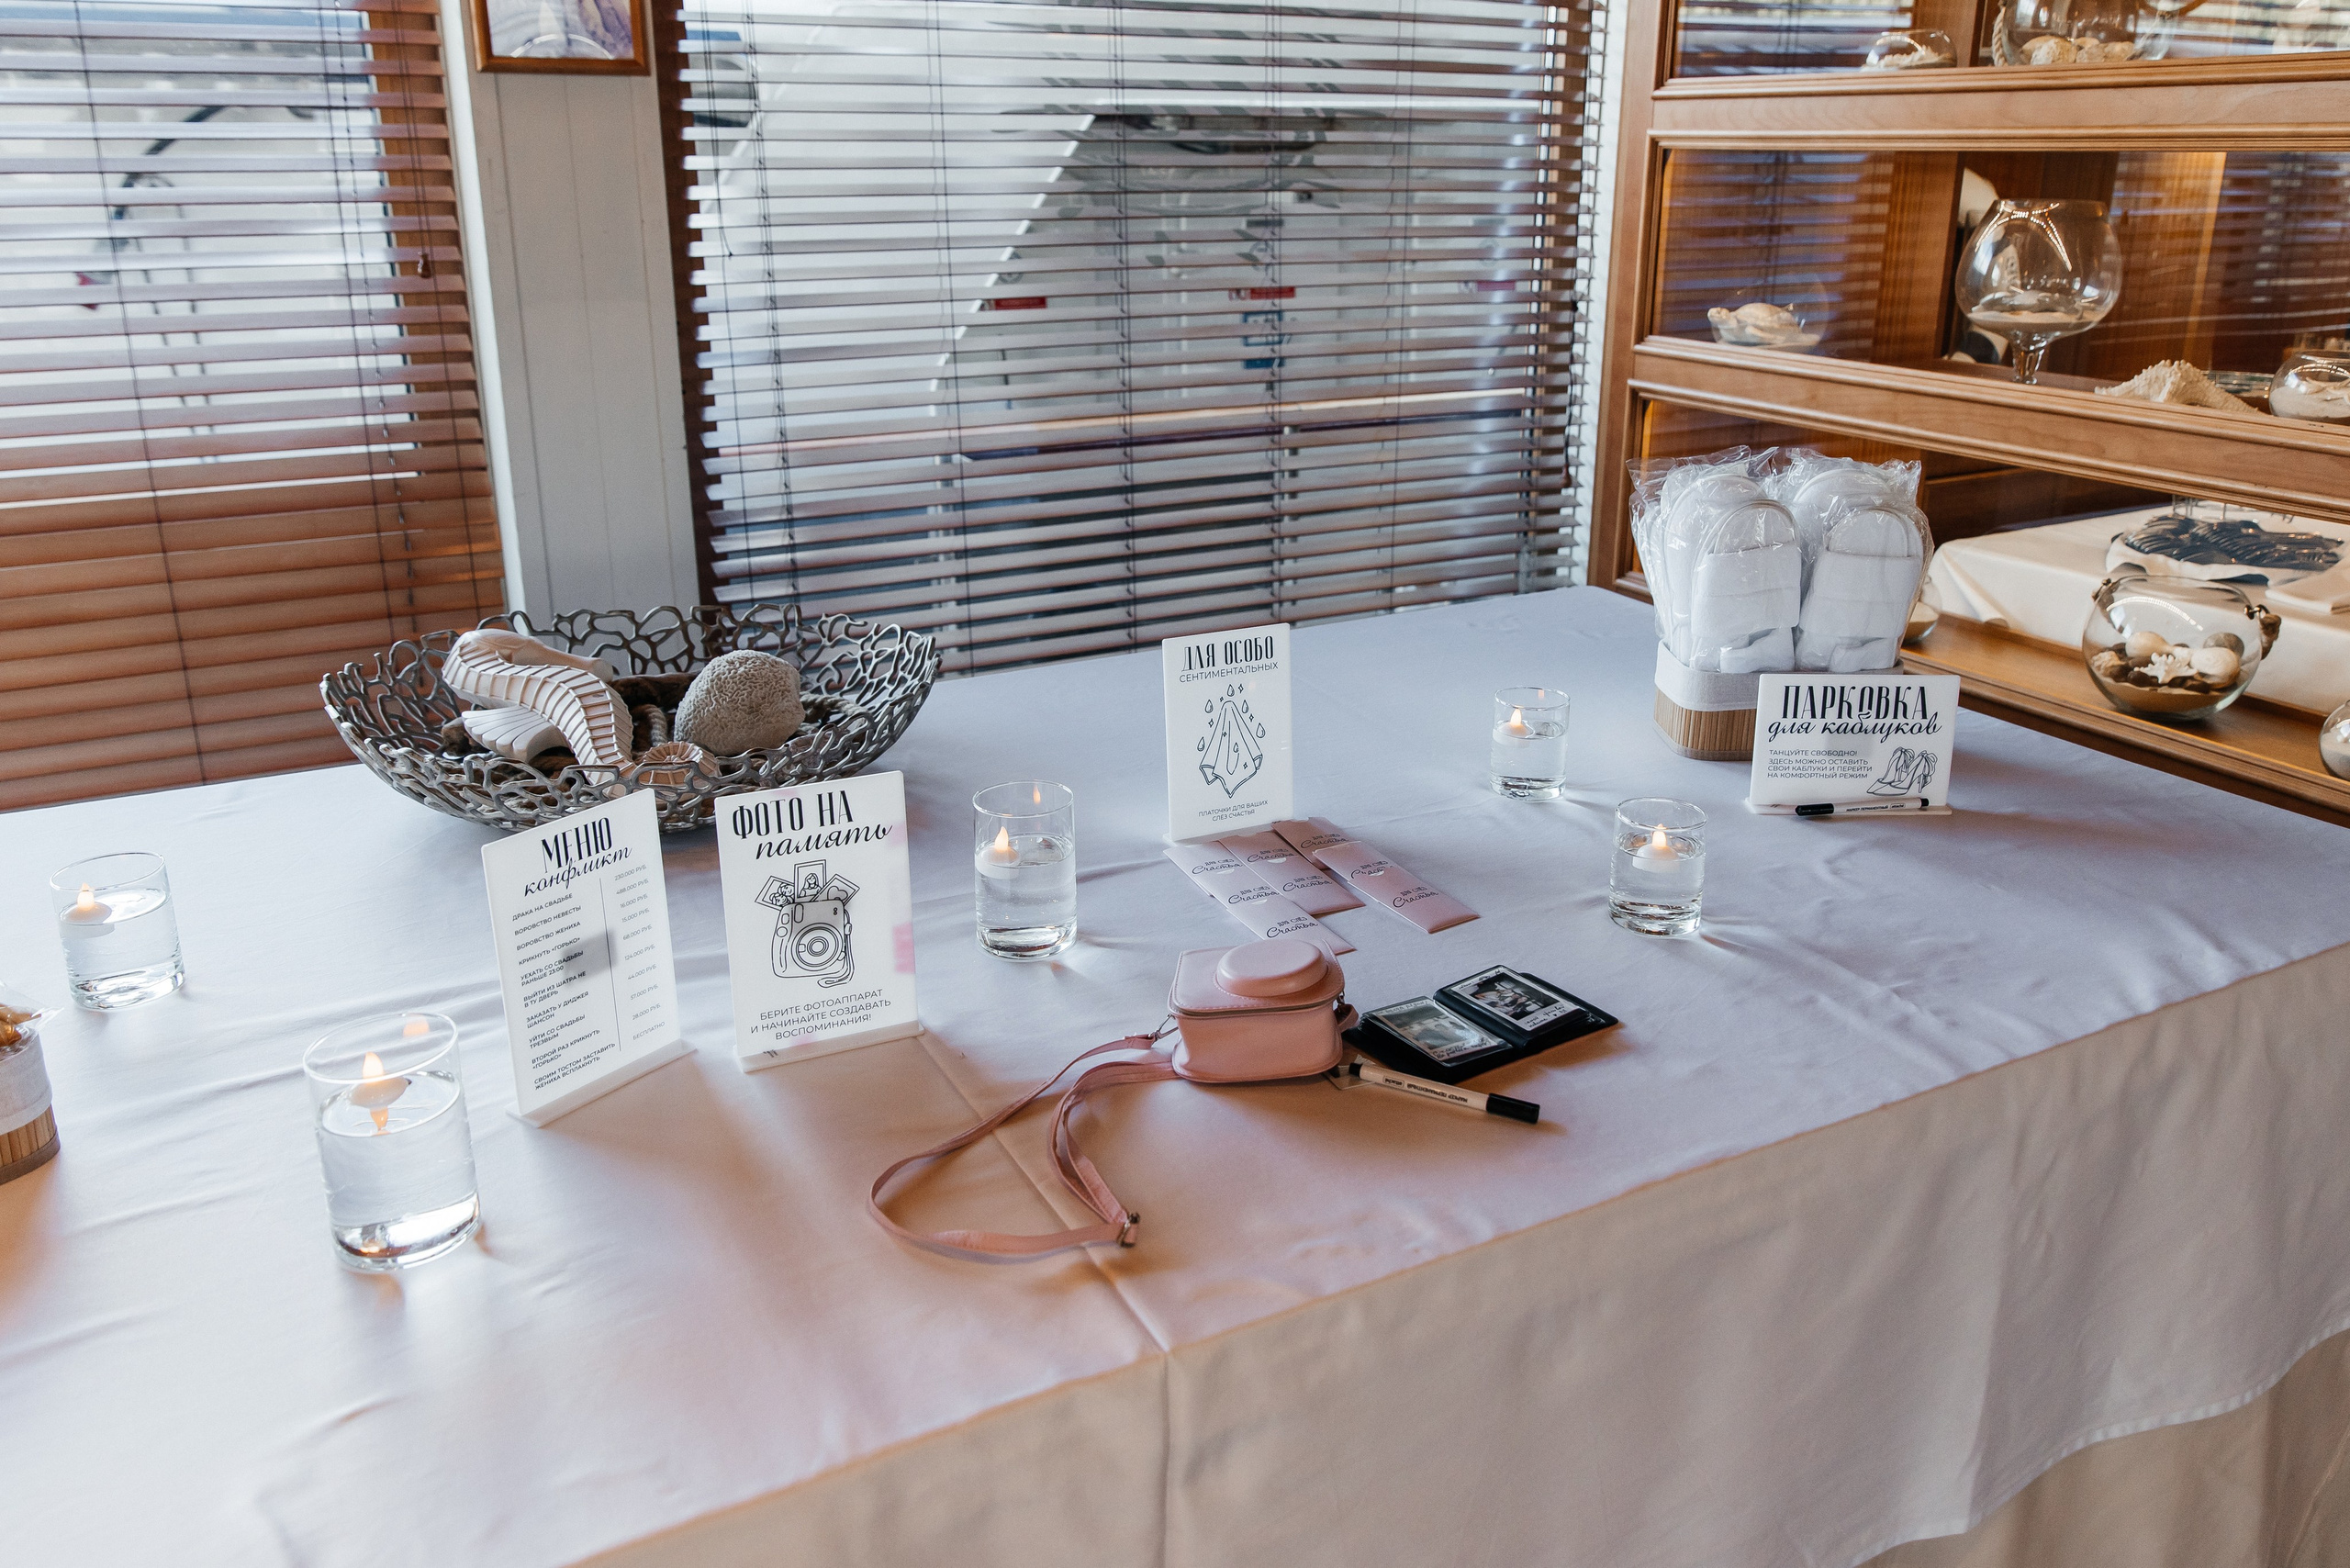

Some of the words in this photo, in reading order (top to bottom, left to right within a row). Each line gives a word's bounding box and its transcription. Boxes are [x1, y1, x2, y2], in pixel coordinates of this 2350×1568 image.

[1181, 643, 1215, 672] ДЛЯ
[1225, 635, 1273, 665] ОСОБО
[1179, 661, 1278, 683] СЕНТИМЕНТАЛЬНЫХ
[1782, 685, 1928, 719] ПАРКОВКА
[1768, 722, 1816, 743] для
[1821, 711, 1942, 743] каблуков
[733, 797, 804, 839] ФОТО
[817, 790, 854, 827] НА
[1199, 807, 1231, 817] ПЛАТОЧКИ
[1247, 800, 1268, 808] ВАШИХ
[1229, 809, 1255, 818] СЧАСТЬЯ
[542, 817, 612, 873] МЕНЮ
[755, 824, 893, 859] память
[524, 847, 632, 897] конфликт
[1192, 863, 1243, 874] Счастья
[1228, 890, 1280, 904] Счастья
[1282, 879, 1333, 892] Счастья
[512, 910, 533, 921] ДРАКА
[544, 893, 573, 908] СВАДЬБЕ
[515, 917, 552, 935] ВОРОВСТВО
[553, 905, 581, 921] НЕВЕСТЫ
[516, 932, 554, 951] ВОРОВСТВО
[555, 921, 581, 935] ЖЕНИХА
[1267, 922, 1318, 938] Счастья
[519, 948, 551, 966] КРИКНУТЬ
[520, 968, 543, 980] УЕХАТЬ
[554, 951, 584, 966] СВАДЬБЫ
[521, 974, 547, 987] РАНЬШЕ
[523, 988, 545, 1002] ВЫЙТИ
[556, 975, 576, 988] ШАТРА
[526, 1006, 557, 1023] ЗАКАЗАТЬ
[564, 991, 588, 1007] ДИДЖЕЯ
[538, 990, 558, 1002] ДВЕРЬ
[760, 1005, 801, 1021] БЕРИТЕ
[803, 989, 883, 1011] ФОТОАППАРАТ
[527, 1013, 555, 1028] ШАНСОН
[529, 1033, 545, 1044] УЙТИ
[556, 1014, 586, 1030] СВАДЬБЫ
[762, 1012, 827, 1032] НАЧИНАЙТЕ
[830, 999, 891, 1017] СОЗДАВАТЬ
[776, 1014, 871, 1040] ВОСПОМИНАНИЯ!
[530, 1033, 559, 1049] ТРЕЗВЫМ
[633, 1022, 666, 1040] БЕСПЛАТНО
[532, 1048, 556, 1064] ВТОРОЙ
[557, 1043, 569, 1052] РАЗ
[569, 1030, 600, 1046] КРИКНУТЬ
[532, 1054, 562, 1070] «ГОРЬКО»
[534, 1070, 556, 1084] СВОИМ
[557, 1058, 582, 1072] ТОСТОМ
[582, 1043, 615, 1061] ЗАСТАВИТЬ
[535, 1075, 561, 1091] ЖЕНИХА
[562, 1057, 600, 1078] ВСПЛАКНУТЬ
